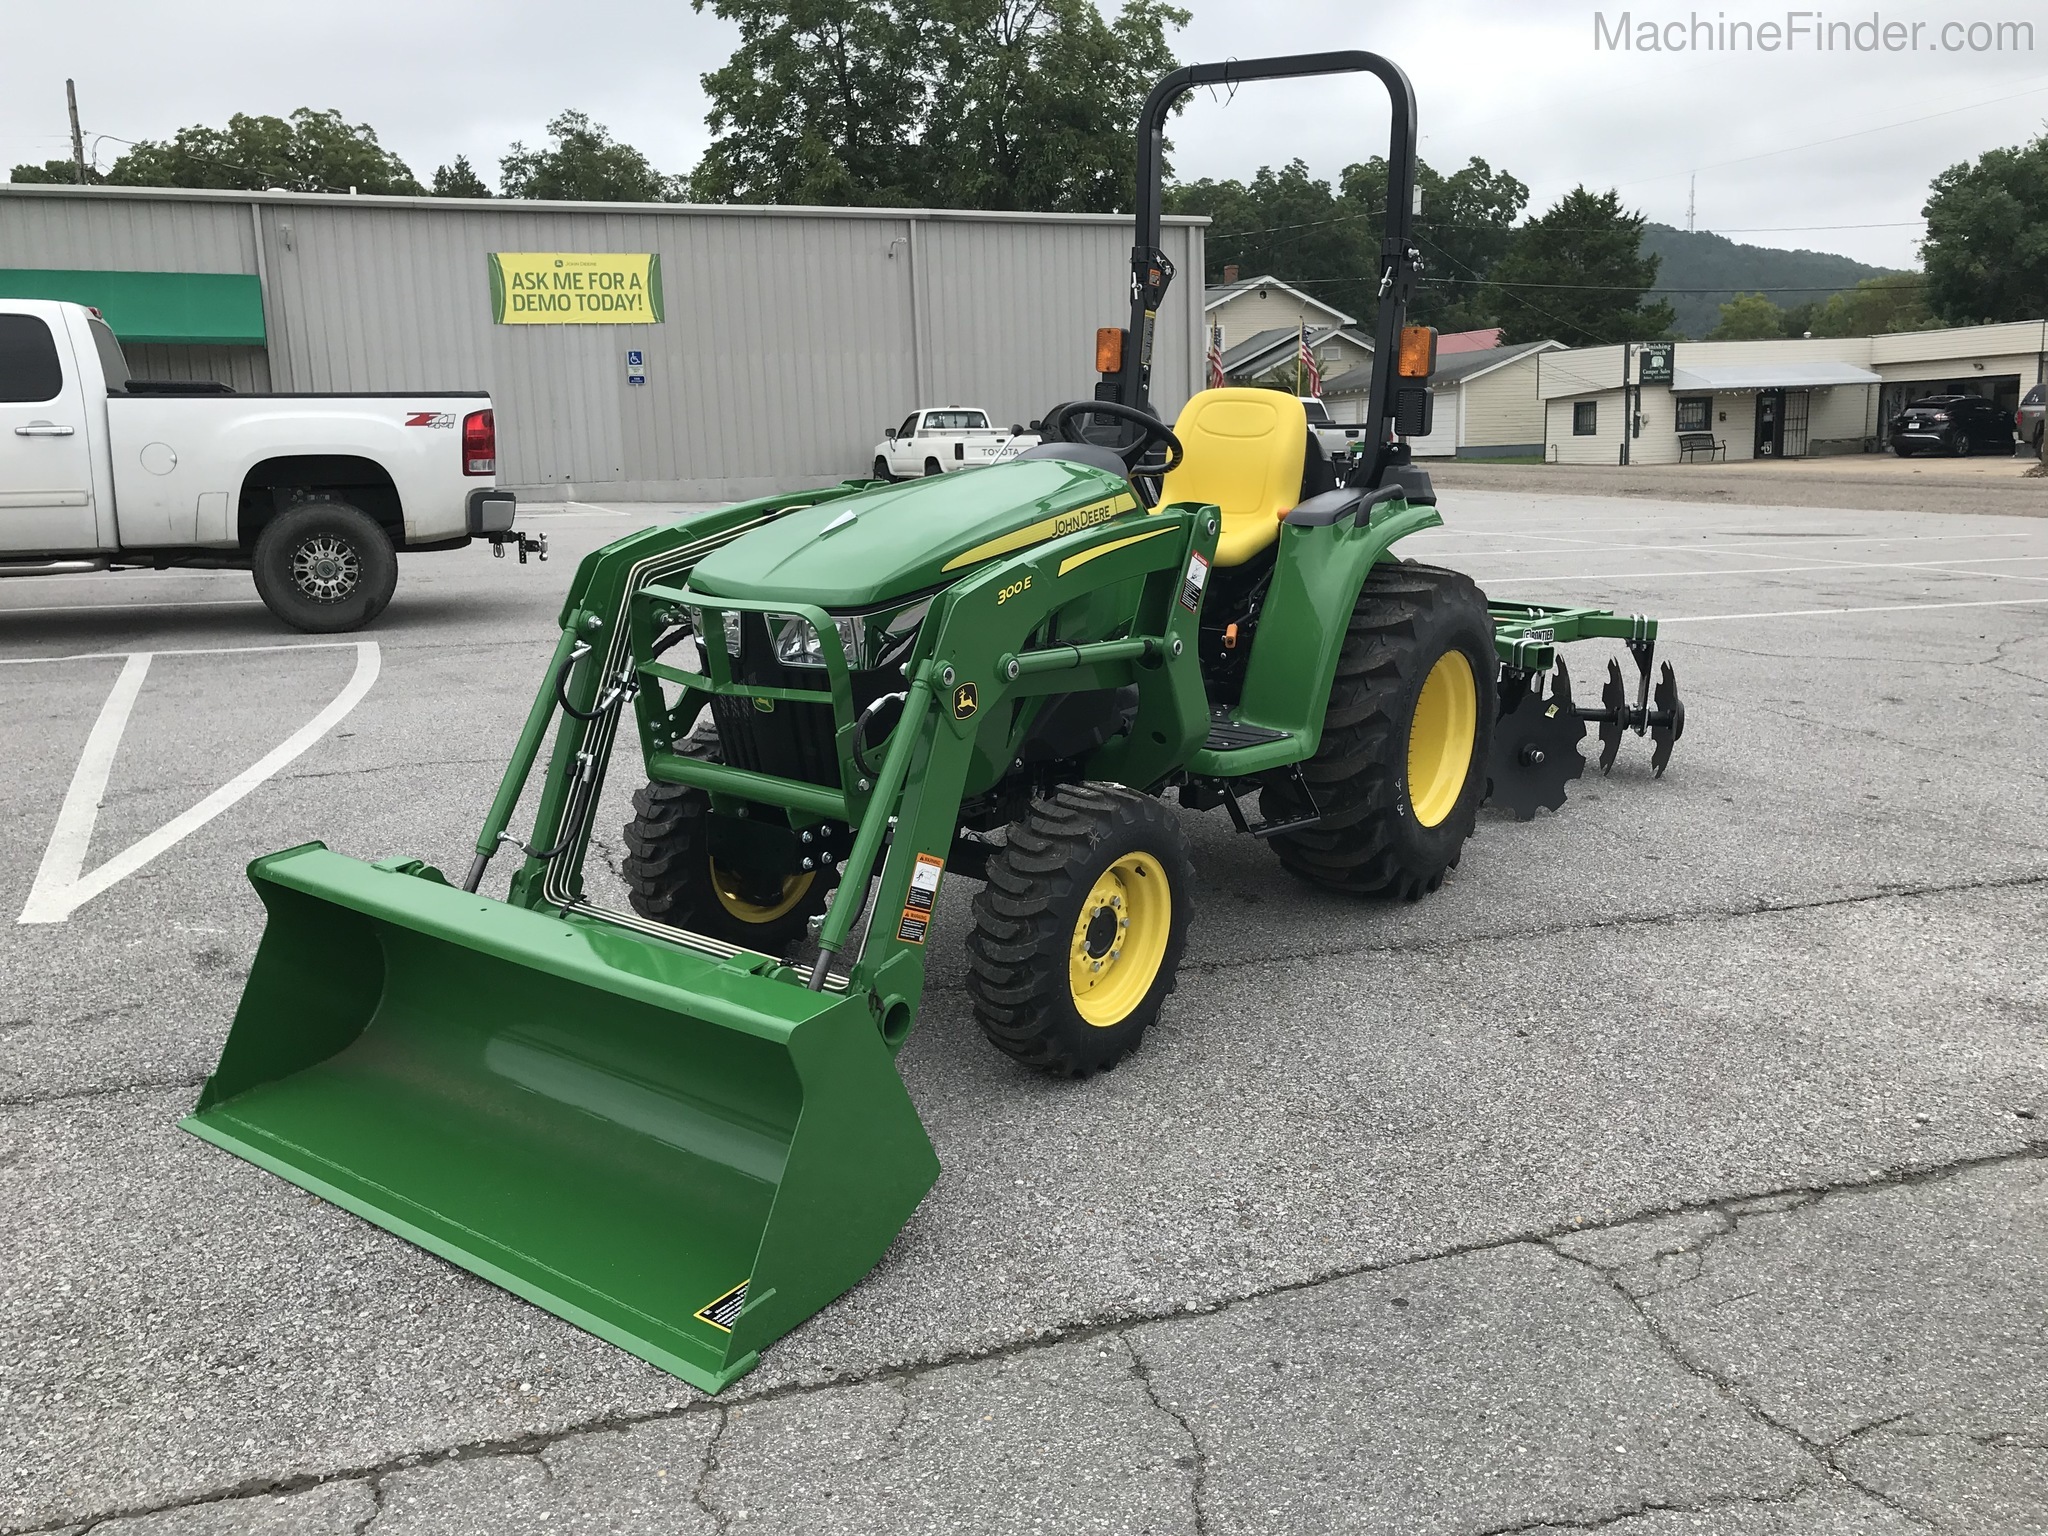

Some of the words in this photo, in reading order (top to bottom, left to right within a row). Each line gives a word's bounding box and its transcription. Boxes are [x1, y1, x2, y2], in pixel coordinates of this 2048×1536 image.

[512, 272, 549, 290] ASK
[553, 272, 584, 290] ME
[588, 272, 625, 290] FOR
[629, 272, 642, 290] A
[512, 293, 571, 312] DEMO
[575, 293, 643, 312] TODAY!
[1051, 516, 1080, 536] JOHN
[1080, 505, 1111, 528] DEERE
